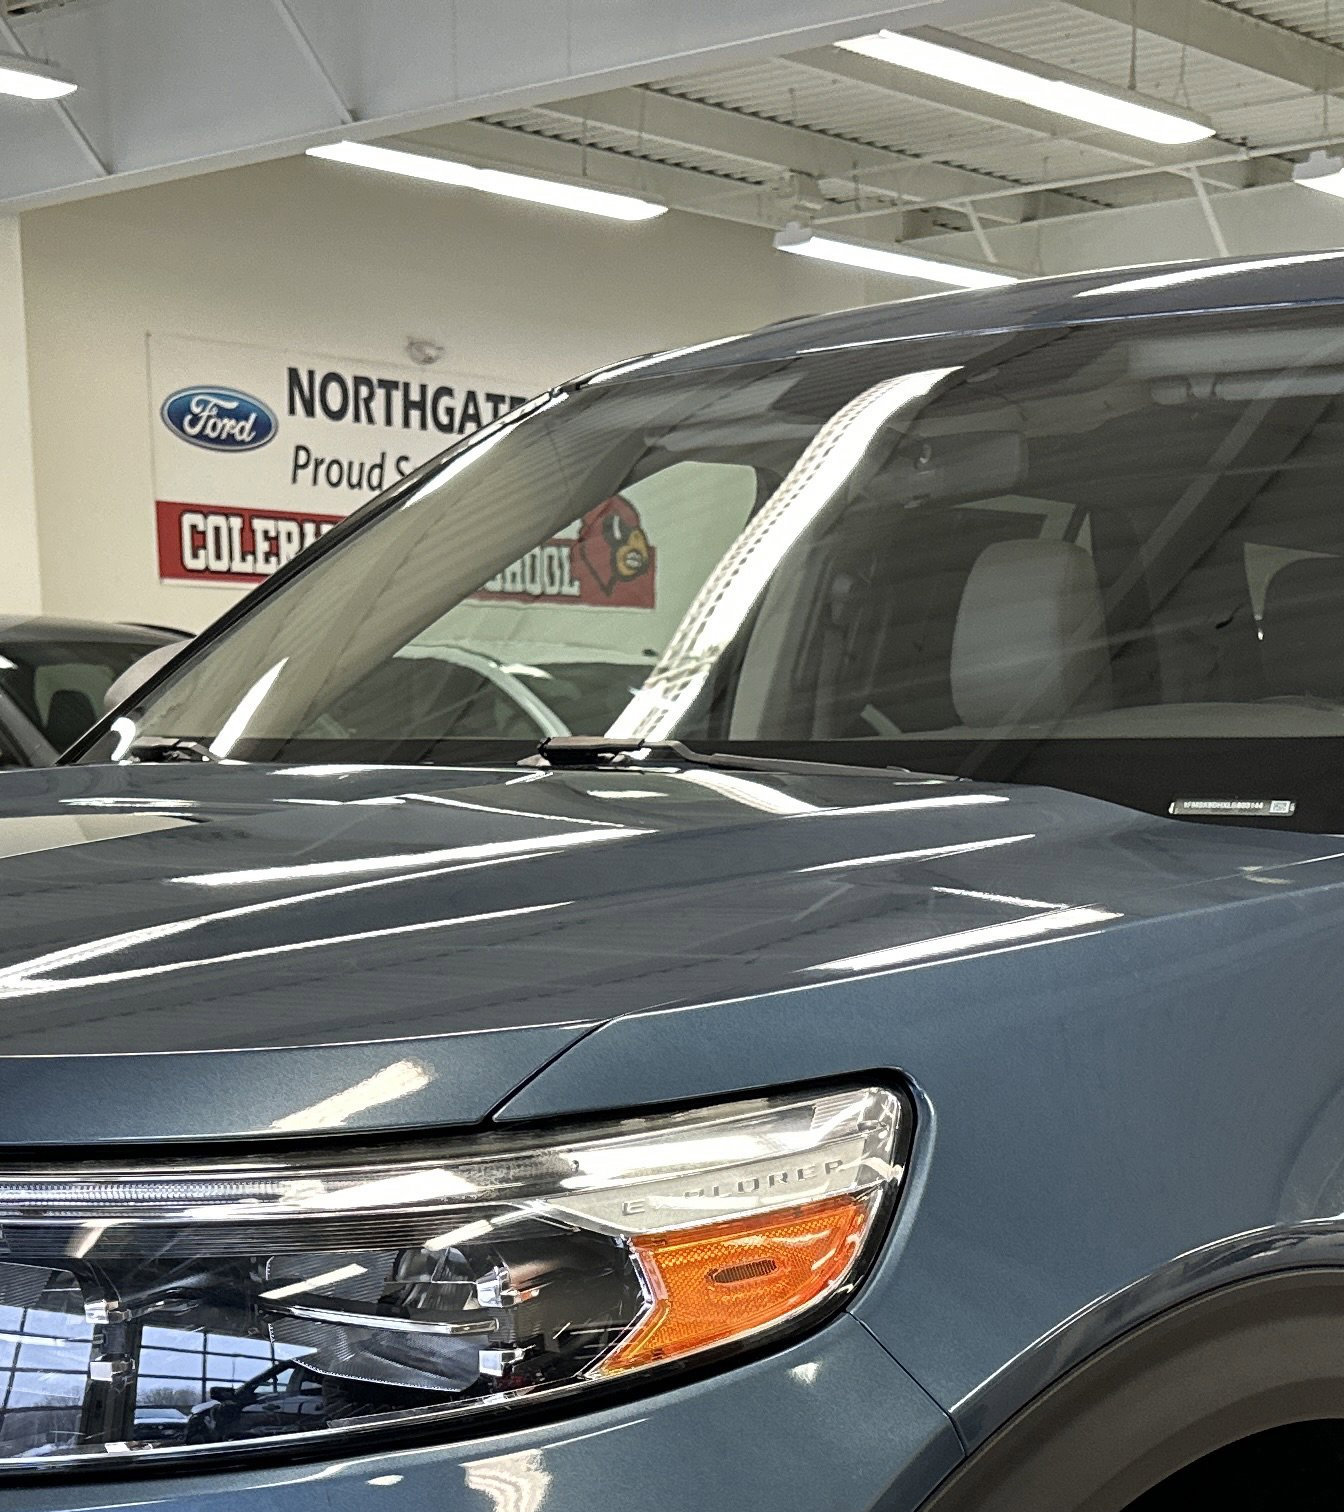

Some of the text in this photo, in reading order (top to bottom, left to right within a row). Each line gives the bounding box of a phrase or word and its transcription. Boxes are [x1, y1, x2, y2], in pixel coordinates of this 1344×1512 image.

[183, 394, 256, 442] Ford
[287, 367, 528, 434] NORTHGAT
[292, 445, 386, 491] Proud
[181, 512, 335, 575] COLER
